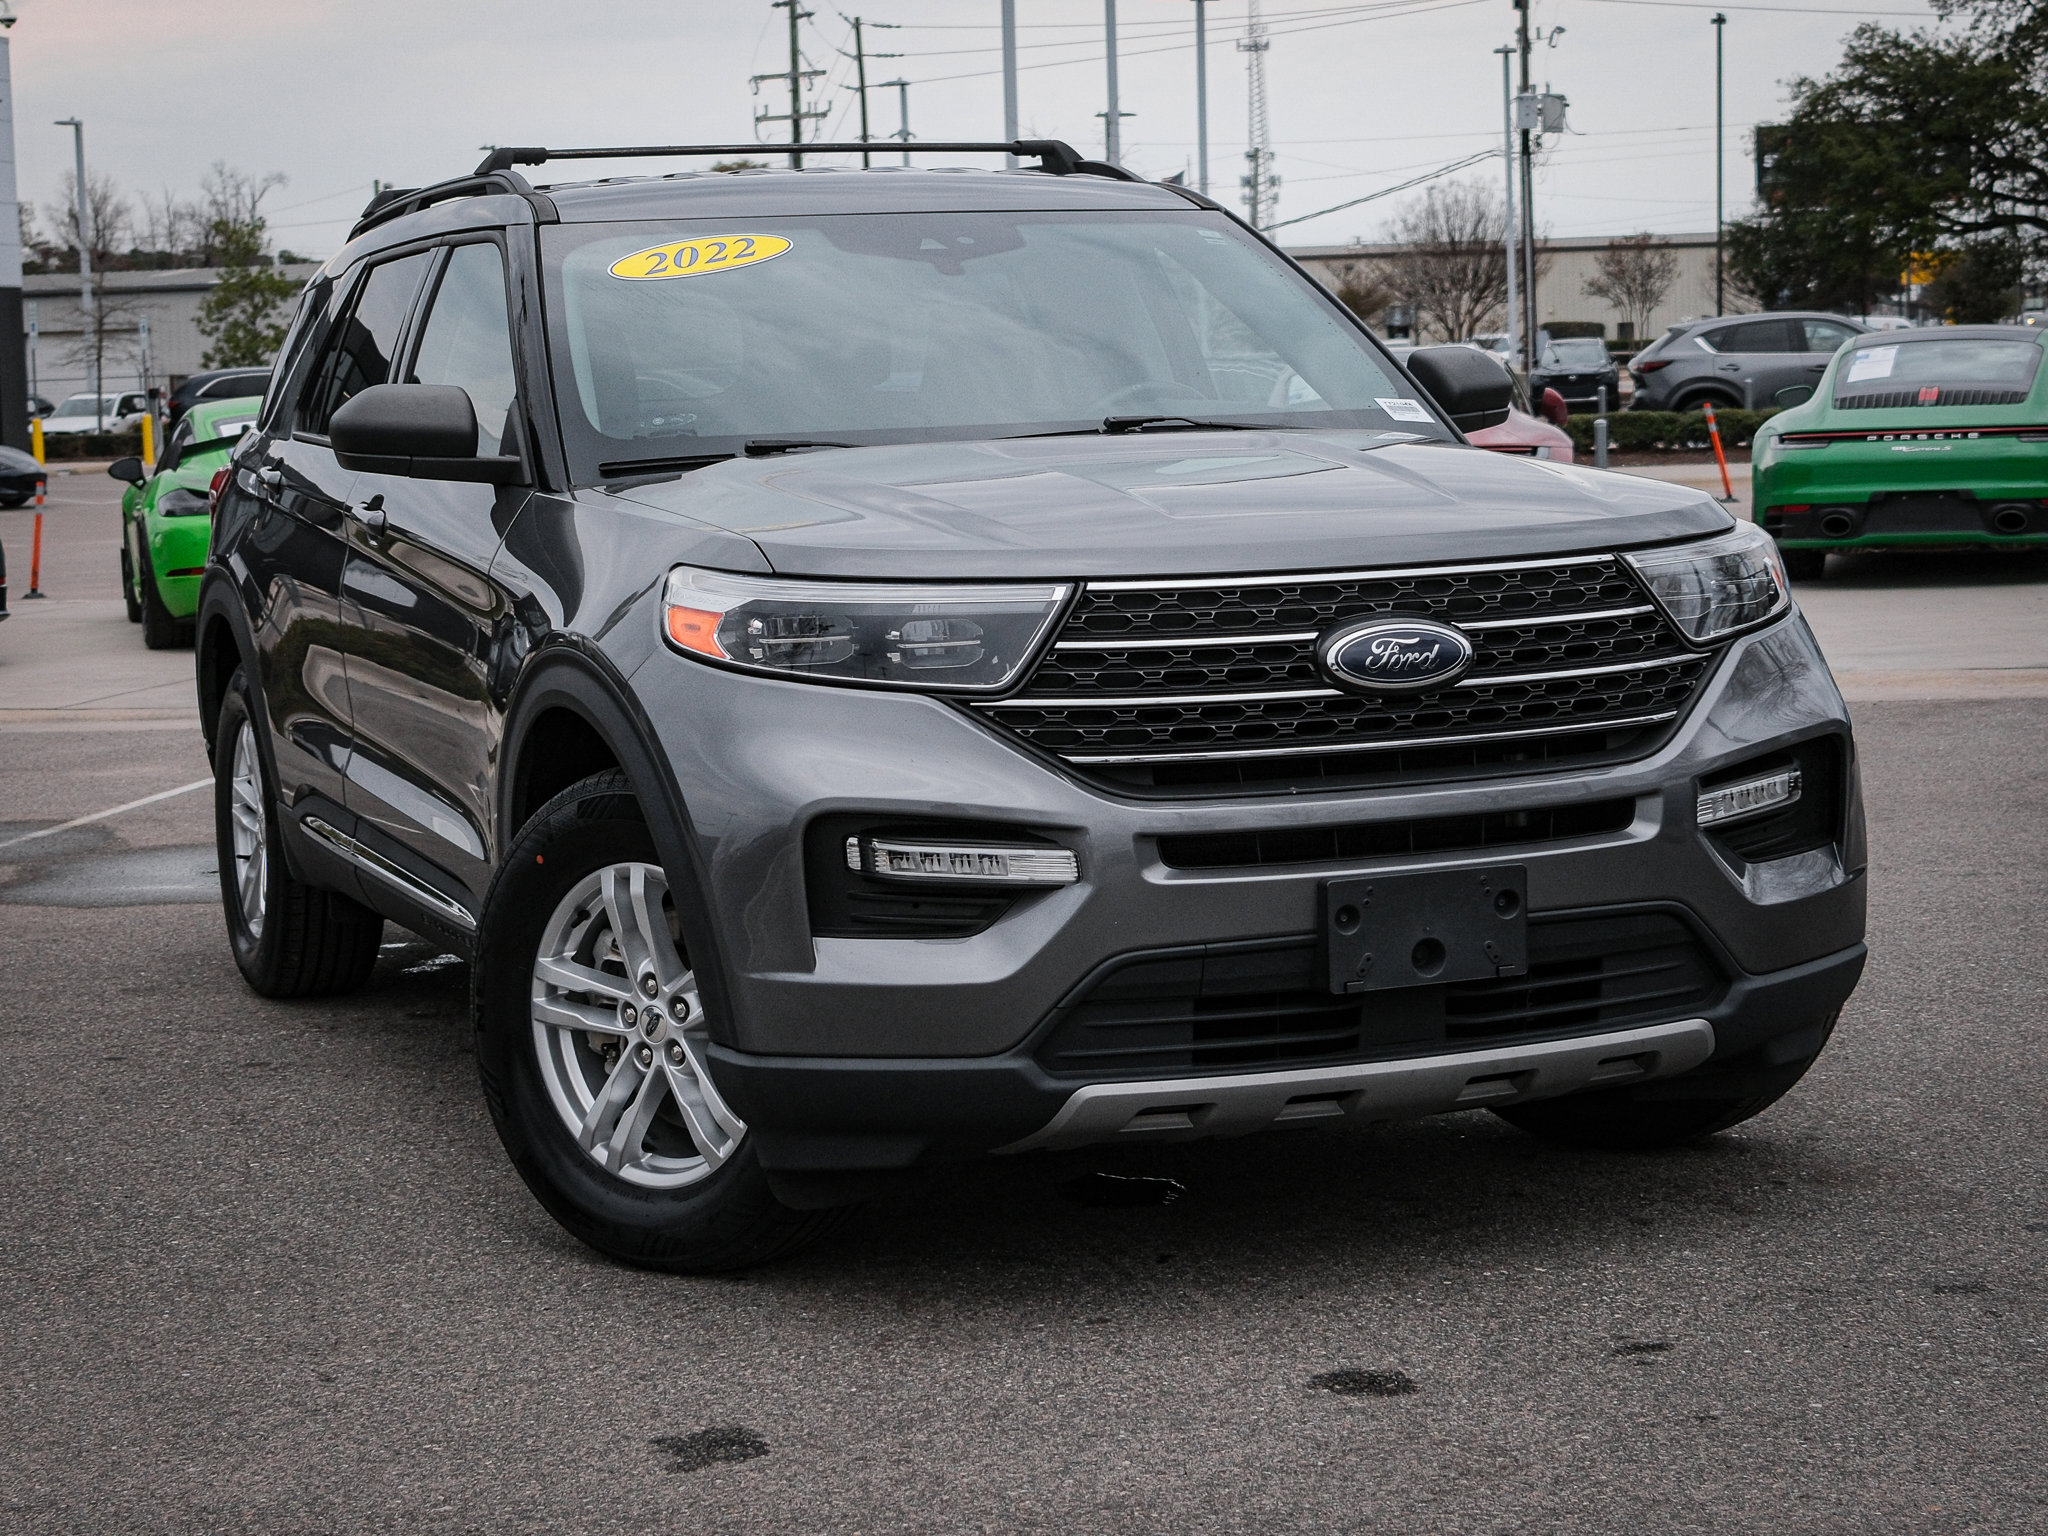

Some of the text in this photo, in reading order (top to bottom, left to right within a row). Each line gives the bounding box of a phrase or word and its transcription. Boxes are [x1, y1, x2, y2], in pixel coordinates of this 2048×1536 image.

[645, 237, 756, 276] 2022
[1866, 432, 1979, 442] PORSCHE
[1365, 637, 1440, 673] Ford
